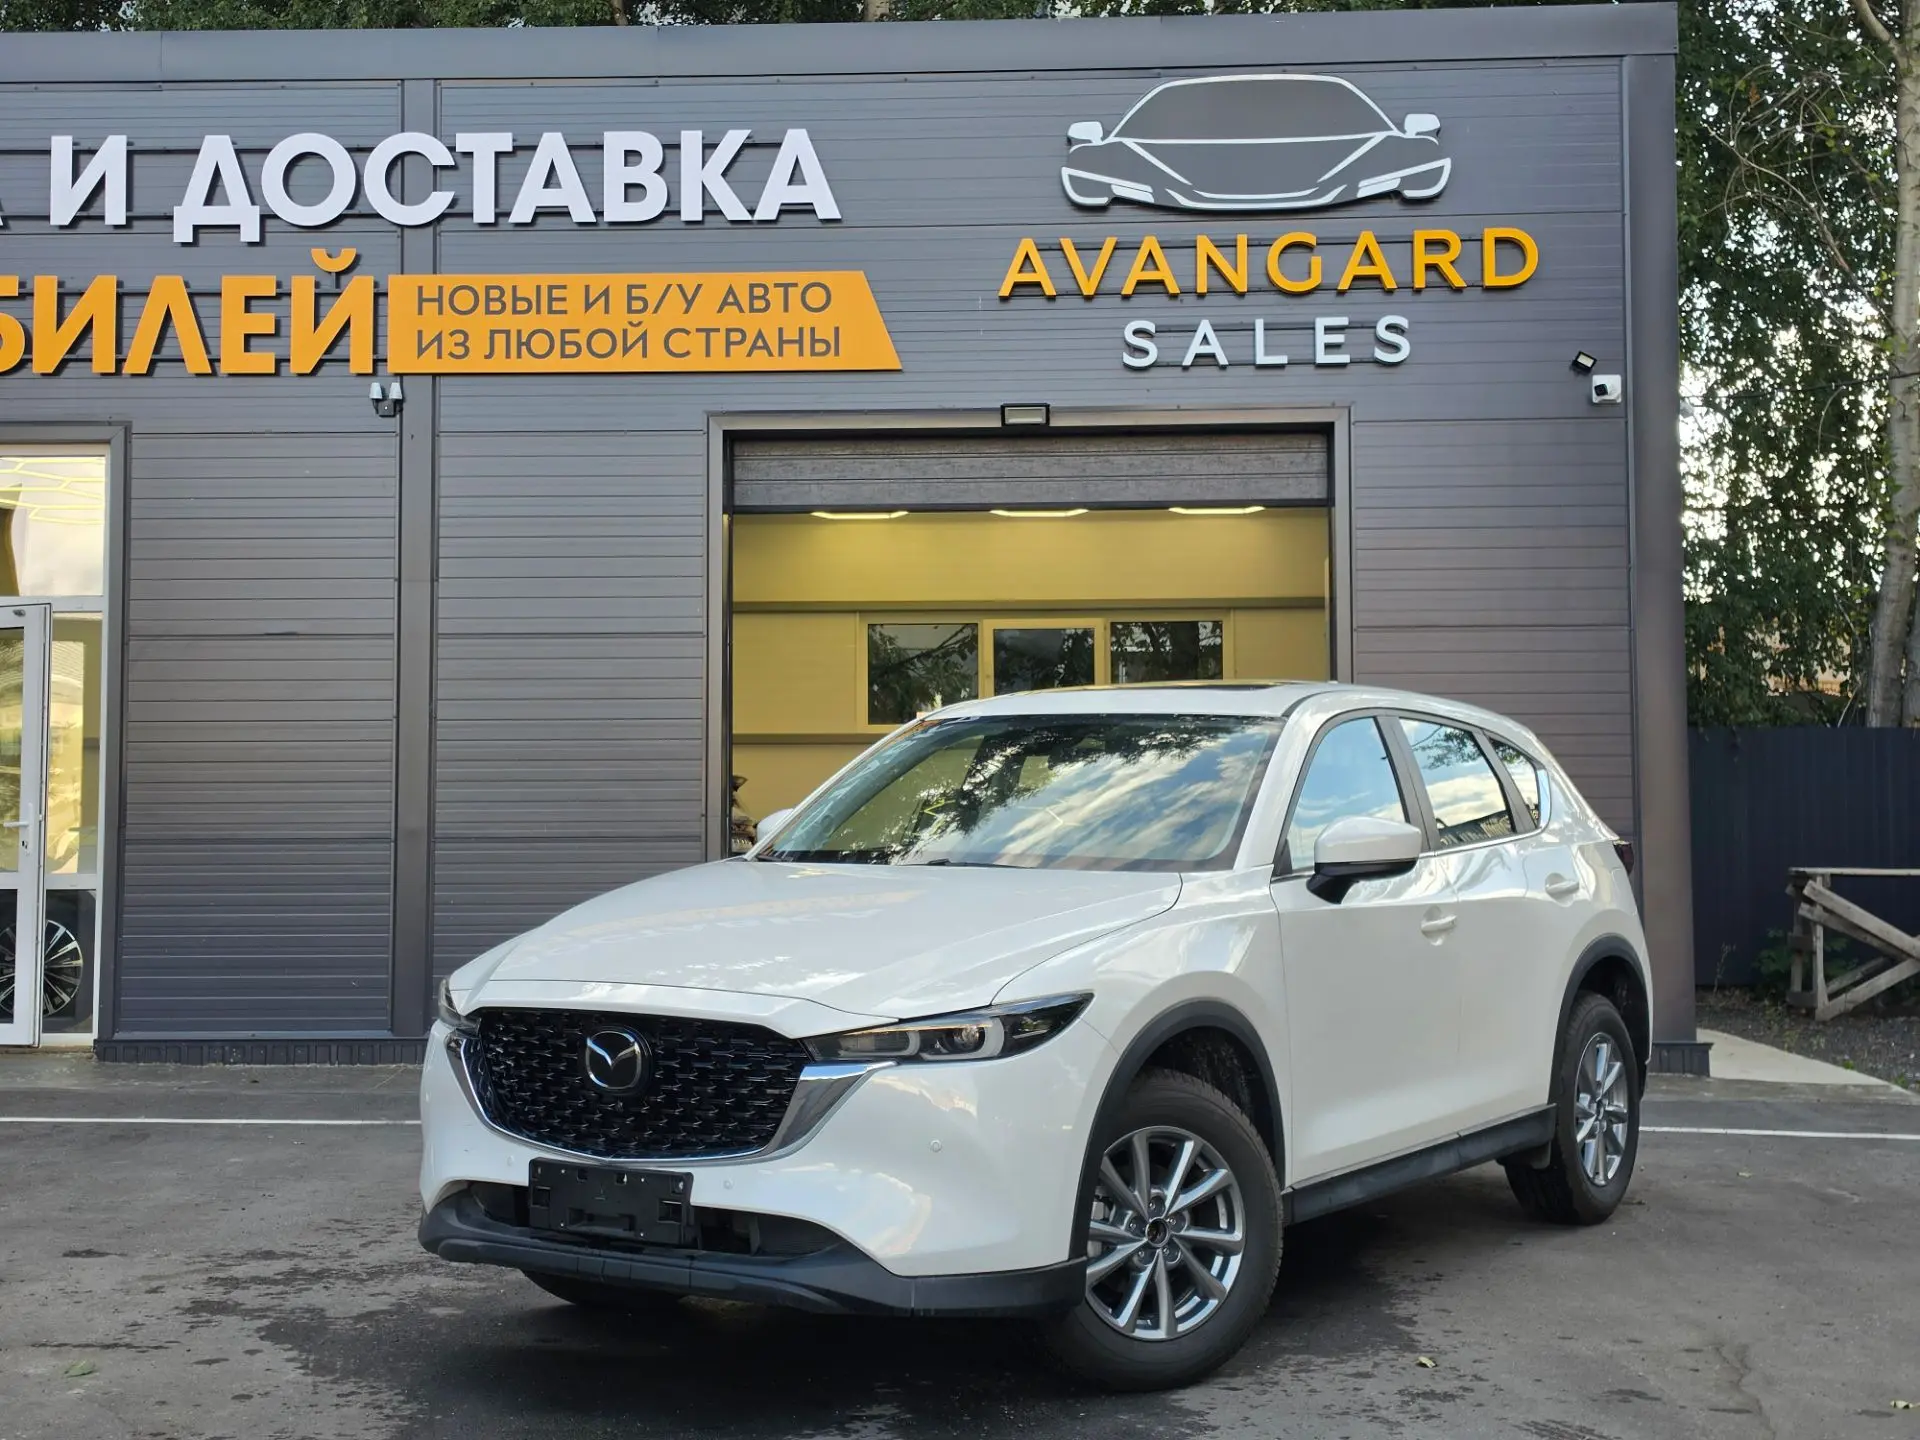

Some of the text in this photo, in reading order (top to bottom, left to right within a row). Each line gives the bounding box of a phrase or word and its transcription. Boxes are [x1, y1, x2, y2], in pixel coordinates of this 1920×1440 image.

[50, 128, 842, 243] И ДОСТАВКА
[998, 227, 1540, 300] AVANGARD
[417, 281, 832, 316] НОВЫЕ И Б/У АВТО
[417, 321, 841, 360] ИЗ ЛЮБОЙ СТРАНЫ
[1122, 315, 1413, 369] SALES
